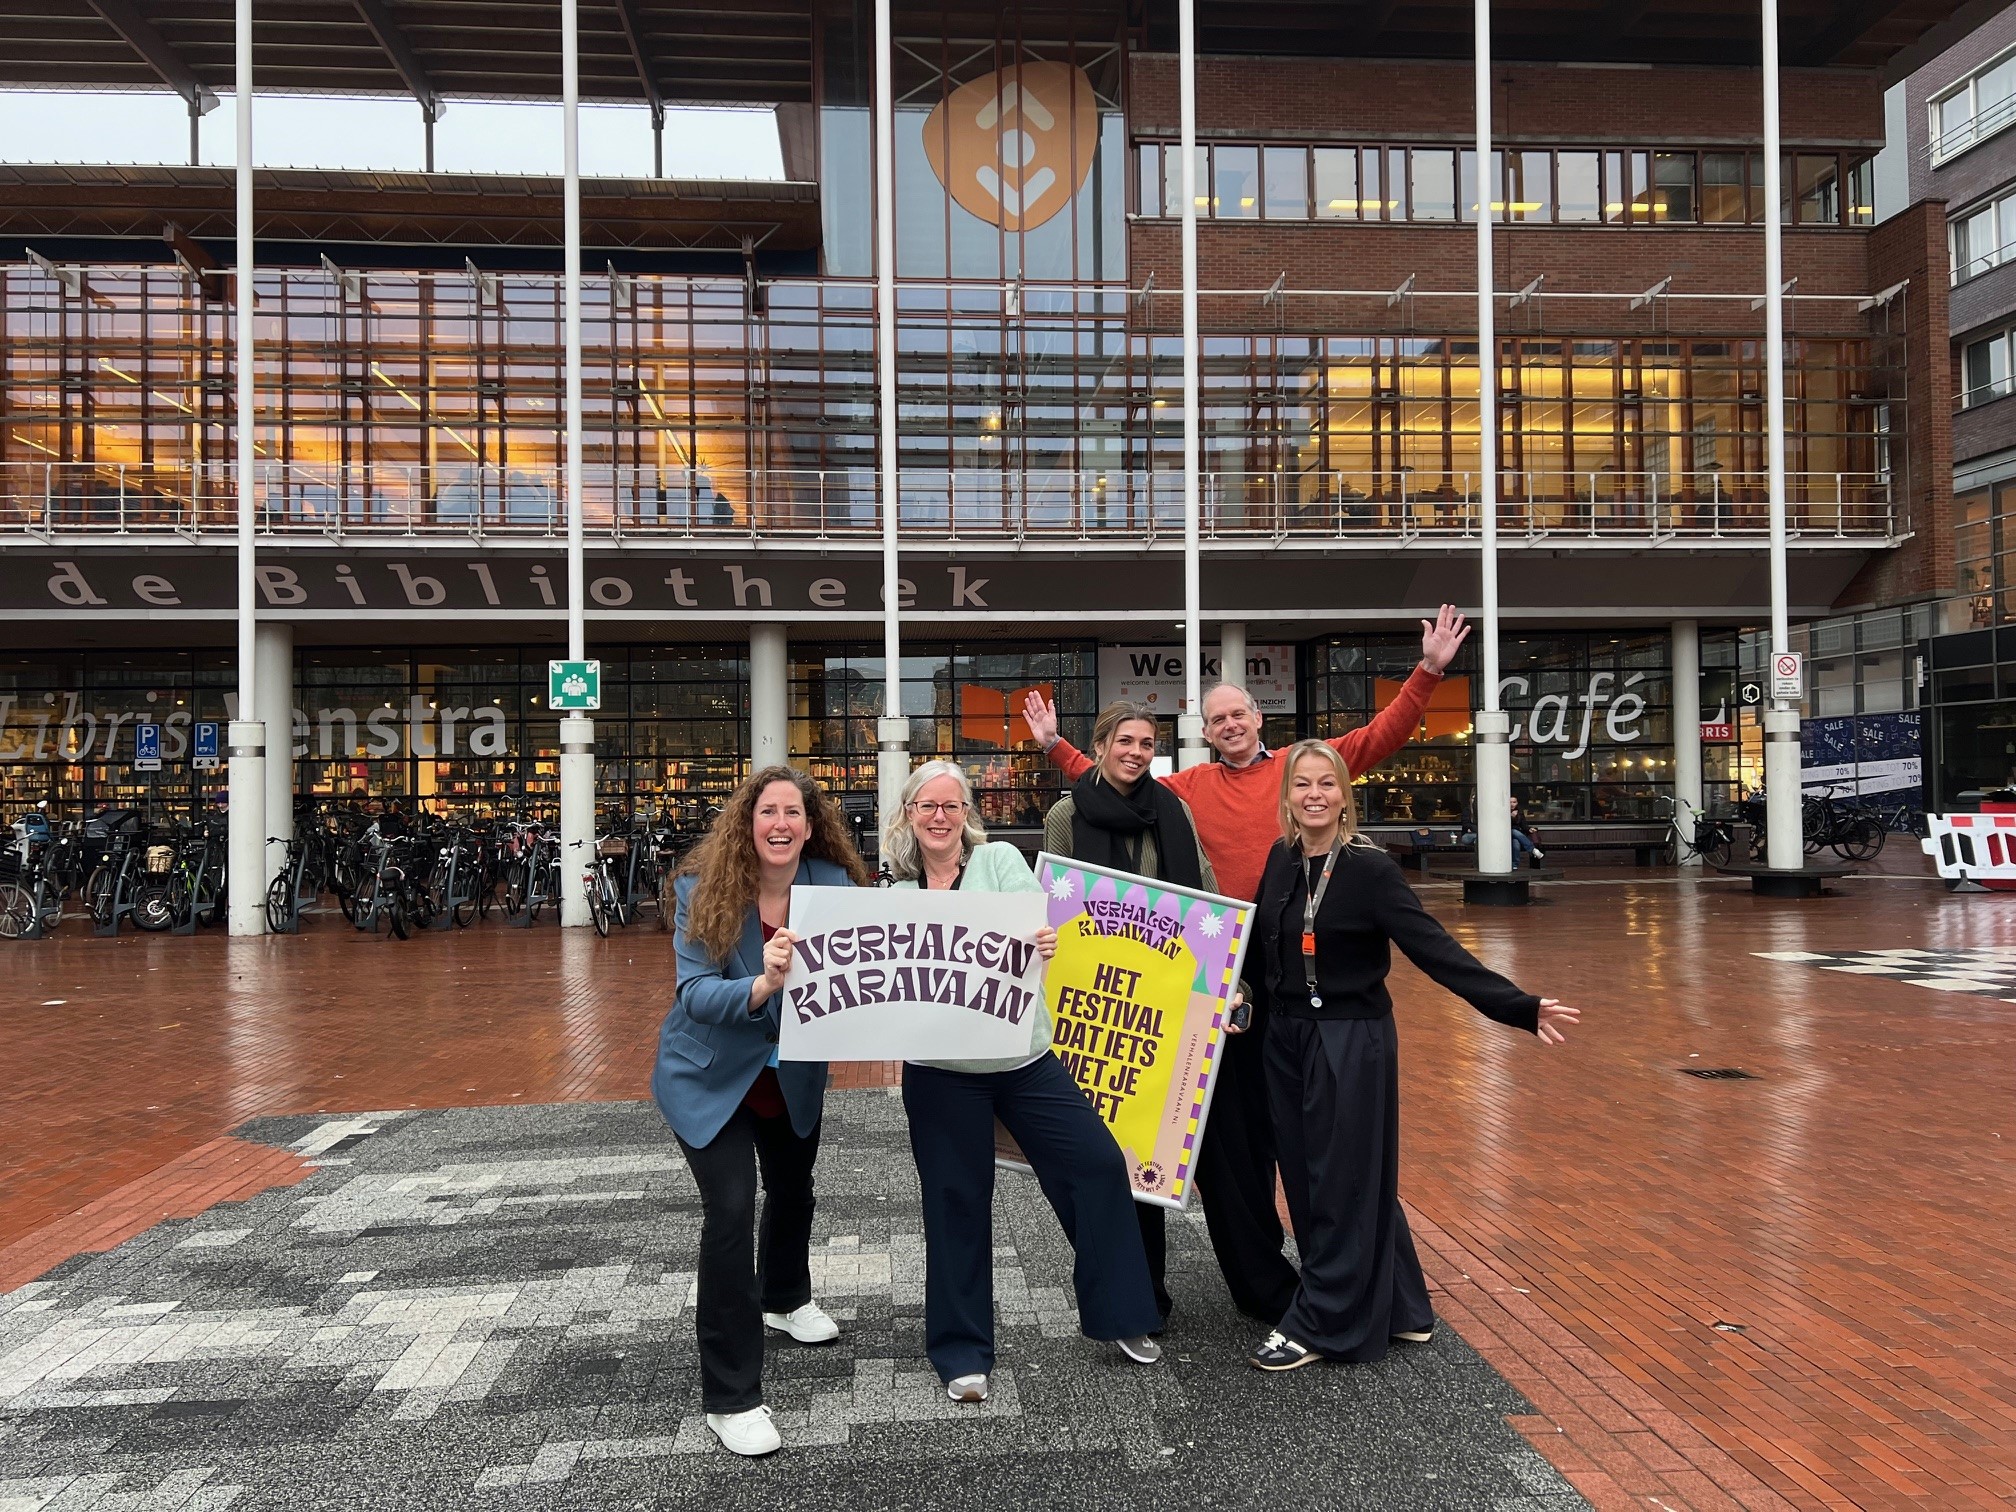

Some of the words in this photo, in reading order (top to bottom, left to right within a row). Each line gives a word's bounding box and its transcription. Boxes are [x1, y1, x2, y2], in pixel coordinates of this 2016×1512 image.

[47, 561, 182, 605] de
[254, 563, 991, 608] Bibliotheek
[1129, 652, 1272, 677] Wekm
[141, 727, 155, 744] P
[200, 724, 213, 742] P
[223, 692, 508, 757] enstra
[1824, 720, 1844, 731] SALE
[1862, 727, 1884, 741] SALE
[1898, 714, 1920, 724] SALE
[1801, 749, 1814, 758] ALE
[1823, 733, 1844, 752] SALE
[1835, 767, 1850, 776] 70%
[1902, 761, 1919, 771] 70%
[1082, 900, 1186, 940] VERHALEN
[792, 923, 1036, 979] VERHALEN
[1078, 919, 1182, 961] KARAVAAN
[788, 966, 1034, 1025] KARAVAAN
[1093, 962, 1143, 999] HET
[1056, 985, 1165, 1039] FESTIVAL
[1052, 1016, 1104, 1054] DAT
[1103, 1029, 1158, 1068] IETS
[1060, 1050, 1109, 1087] MET
[1108, 1064, 1142, 1096] JE
